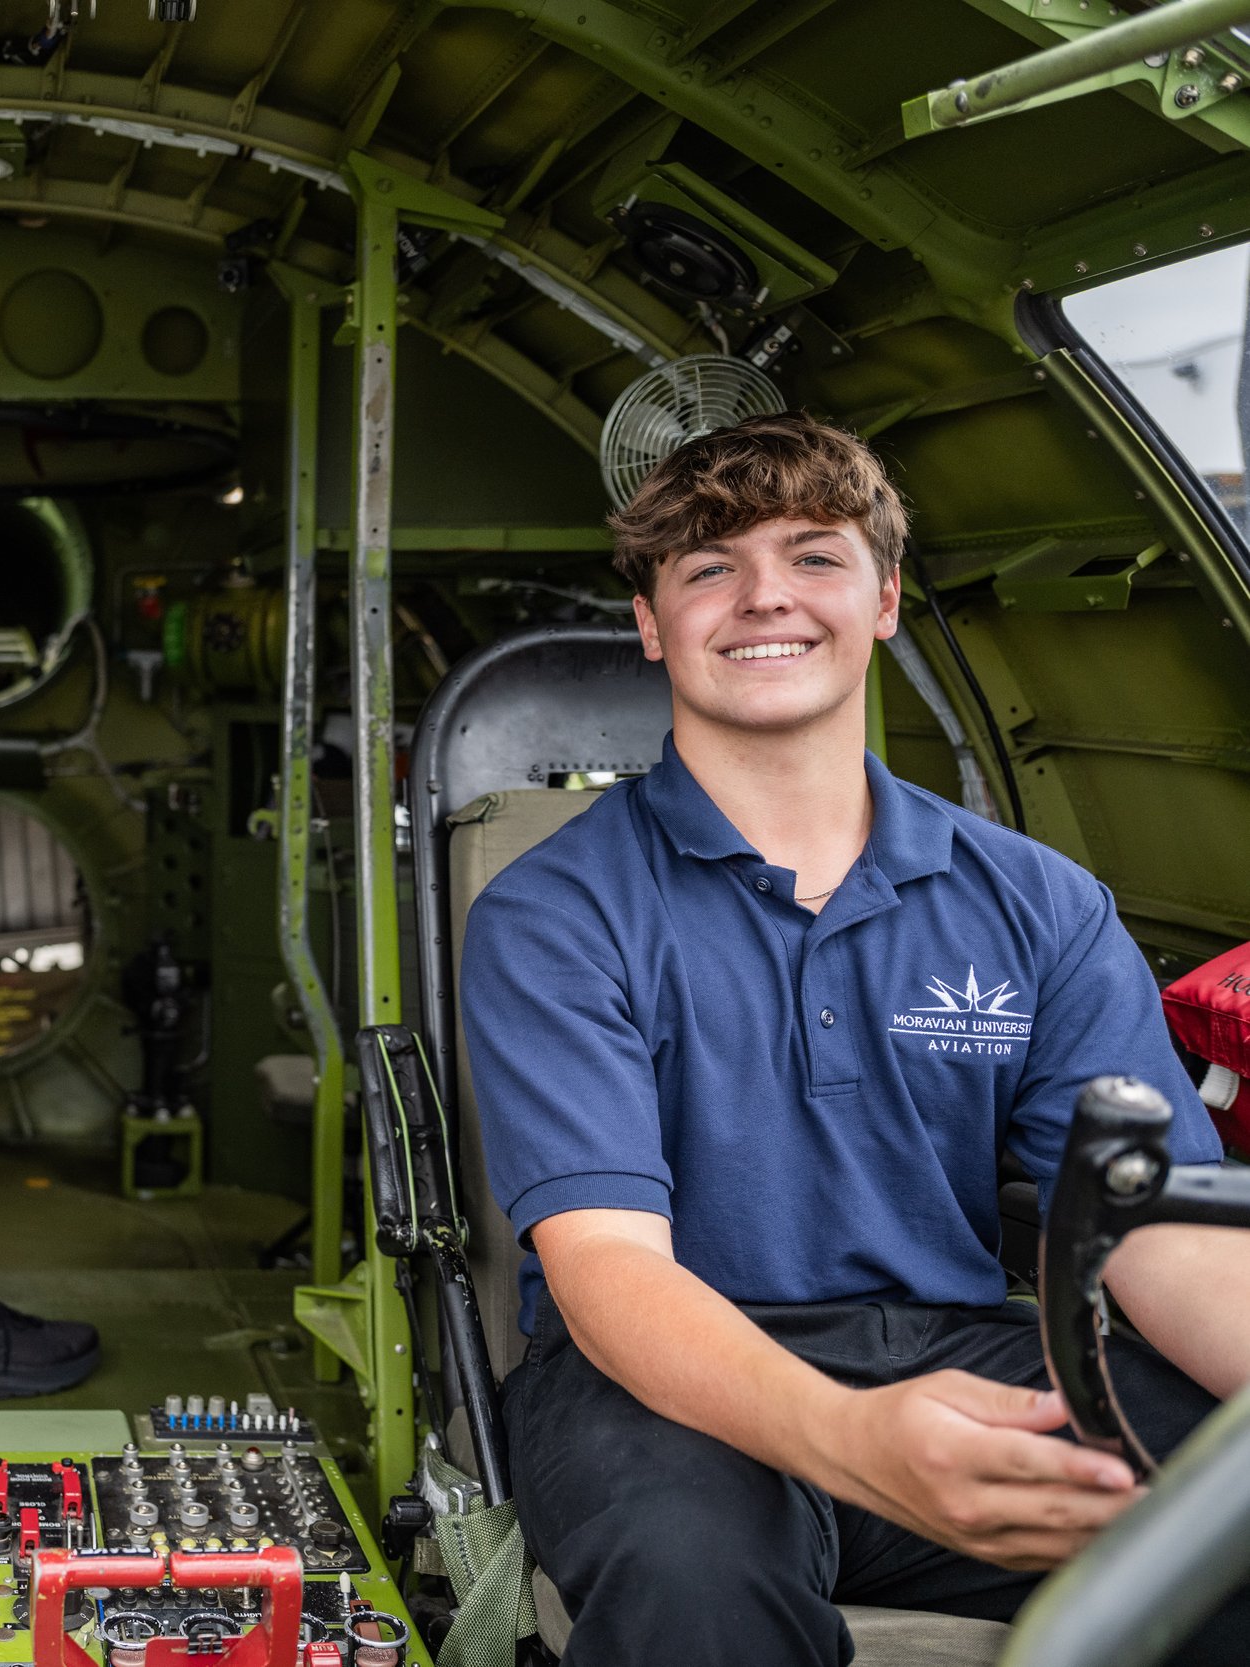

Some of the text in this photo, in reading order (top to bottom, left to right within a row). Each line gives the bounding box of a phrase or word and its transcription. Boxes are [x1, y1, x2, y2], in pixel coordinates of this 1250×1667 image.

[1217, 972, 1250, 996] HO
[893, 1014, 1032, 1035] MORAVIAN UNIVERSIT
[928, 1040, 1012, 1055] AVIATION
